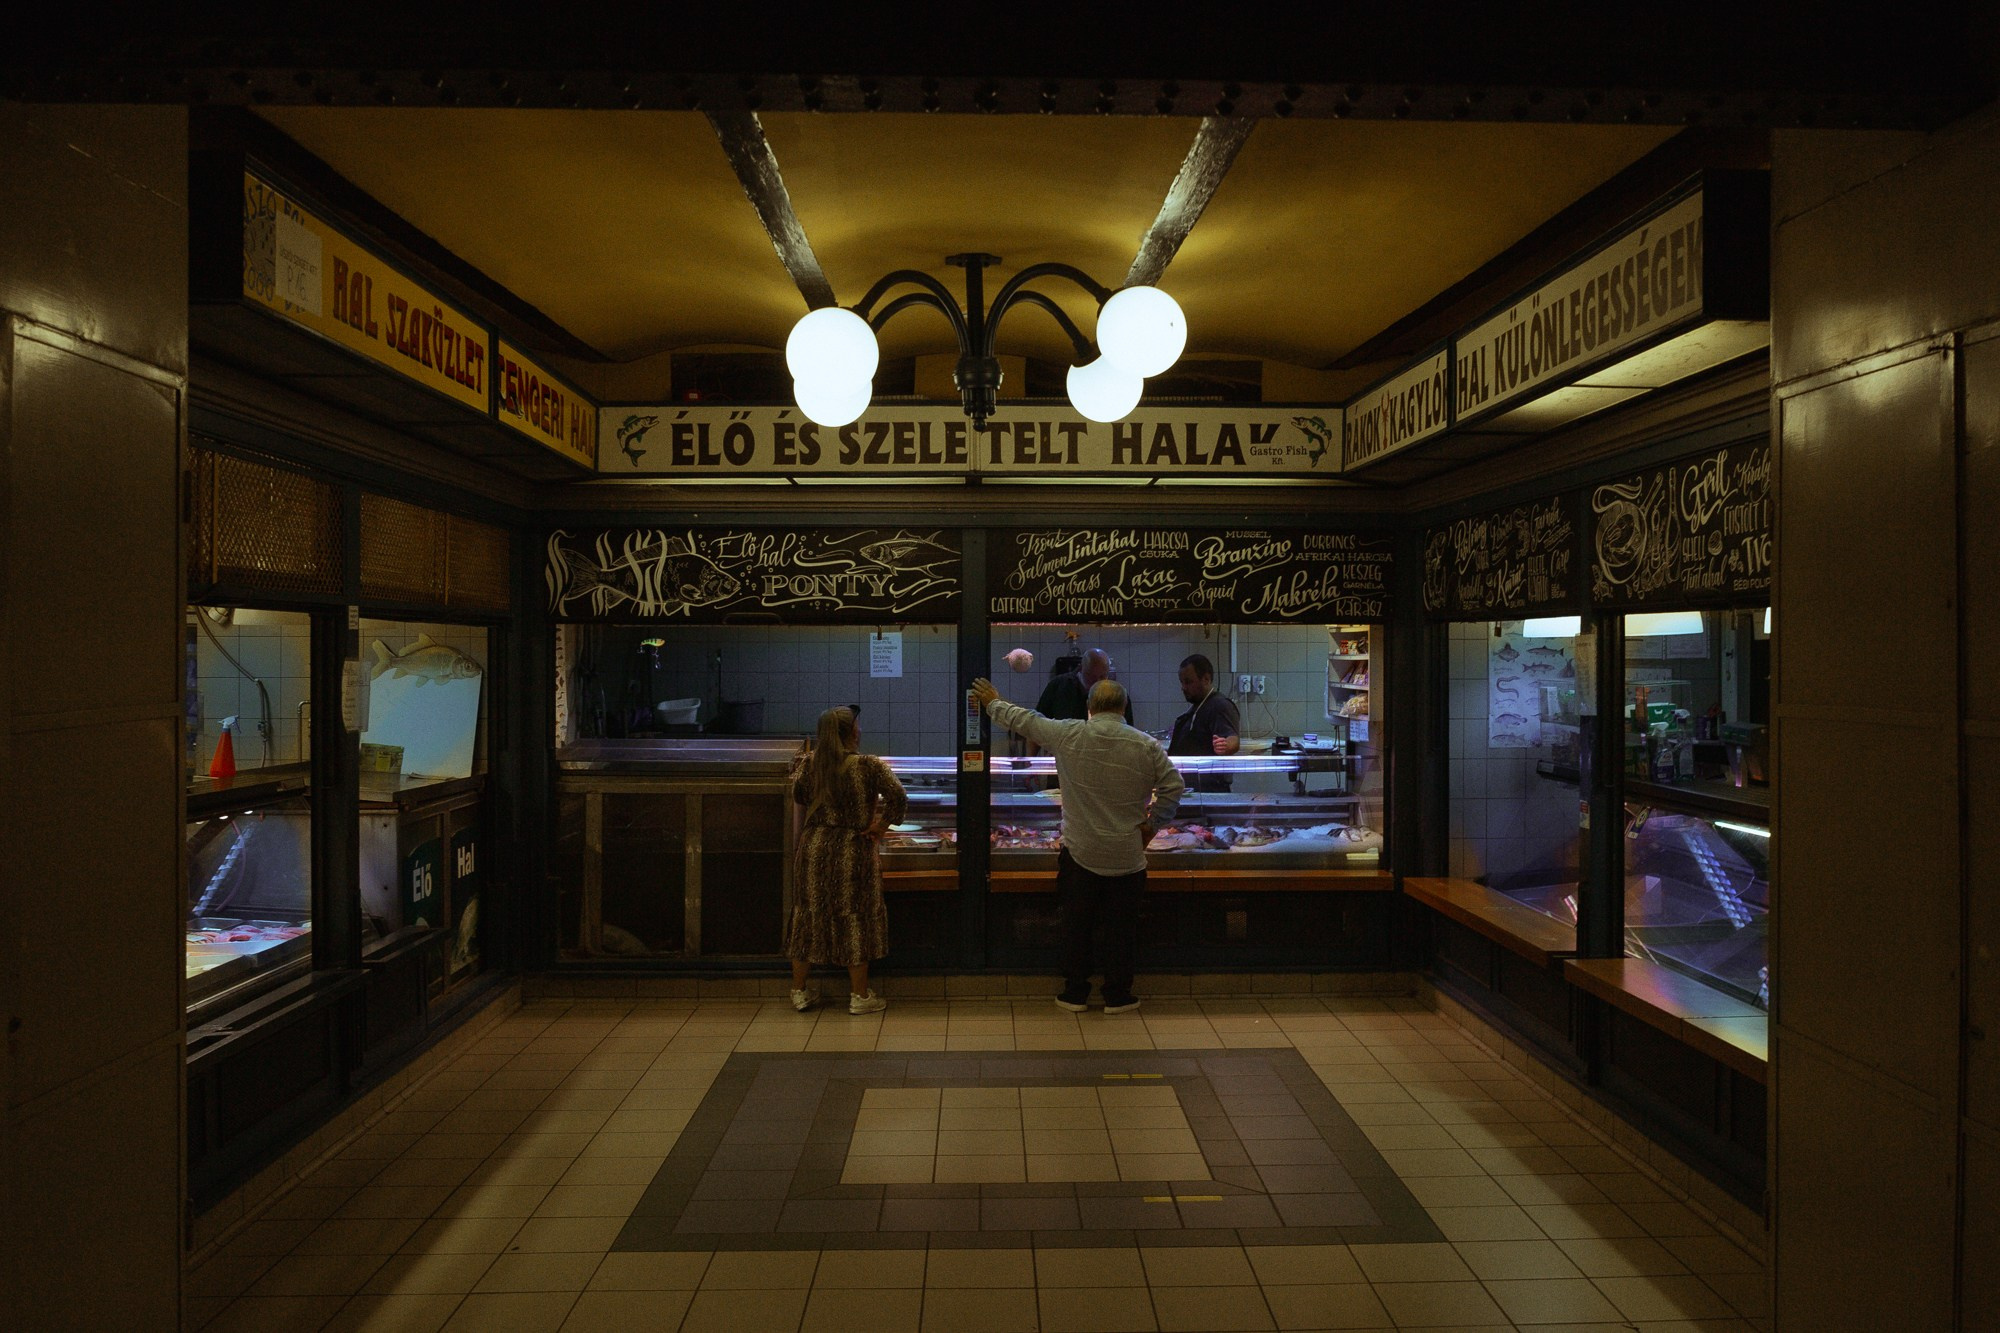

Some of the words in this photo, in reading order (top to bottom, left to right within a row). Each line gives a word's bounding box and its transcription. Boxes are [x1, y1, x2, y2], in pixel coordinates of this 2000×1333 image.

[333, 255, 378, 340] HAL
[386, 293, 484, 394] SZAKÜZLET
[1458, 346, 1489, 415] HAL
[670, 411, 755, 466] ÉLŐ
[772, 410, 822, 466] ÉS
[1250, 446, 1280, 456] Gastro
[1286, 445, 1308, 455] Fish
[1346, 405, 1380, 465] RÁKOK
[1680, 449, 1731, 534] Grill
[1016, 528, 1070, 557] Trout
[1056, 529, 1139, 566] Tintahal
[1144, 531, 1189, 550] HARCSA
[1225, 530, 1272, 539] MUSSEL
[1303, 534, 1356, 550] DURBINCS
[1682, 534, 1707, 563] SHELL
[753, 532, 796, 569] hal
[1139, 551, 1180, 559] CSUKA
[1194, 536, 1292, 568] Branzino
[1295, 552, 1345, 562] AFRIKAI
[1347, 552, 1394, 562] HARCSA
[761, 574, 893, 597] PONTY
[1004, 554, 1068, 591] Salmon
[1108, 554, 1178, 600] Lazac
[1342, 564, 1383, 582] KESZEG
[1035, 575, 1066, 606] Sea
[1066, 572, 1101, 595] bass
[1133, 598, 1182, 609] PONTY
[1187, 578, 1237, 609] Squid
[1241, 565, 1342, 615] Makréla
[991, 597, 1035, 614] CATFISH
[1057, 594, 1124, 616] PISZTRÁNG
[457, 842, 475, 879] Hal
[412, 860, 432, 903] Élő
